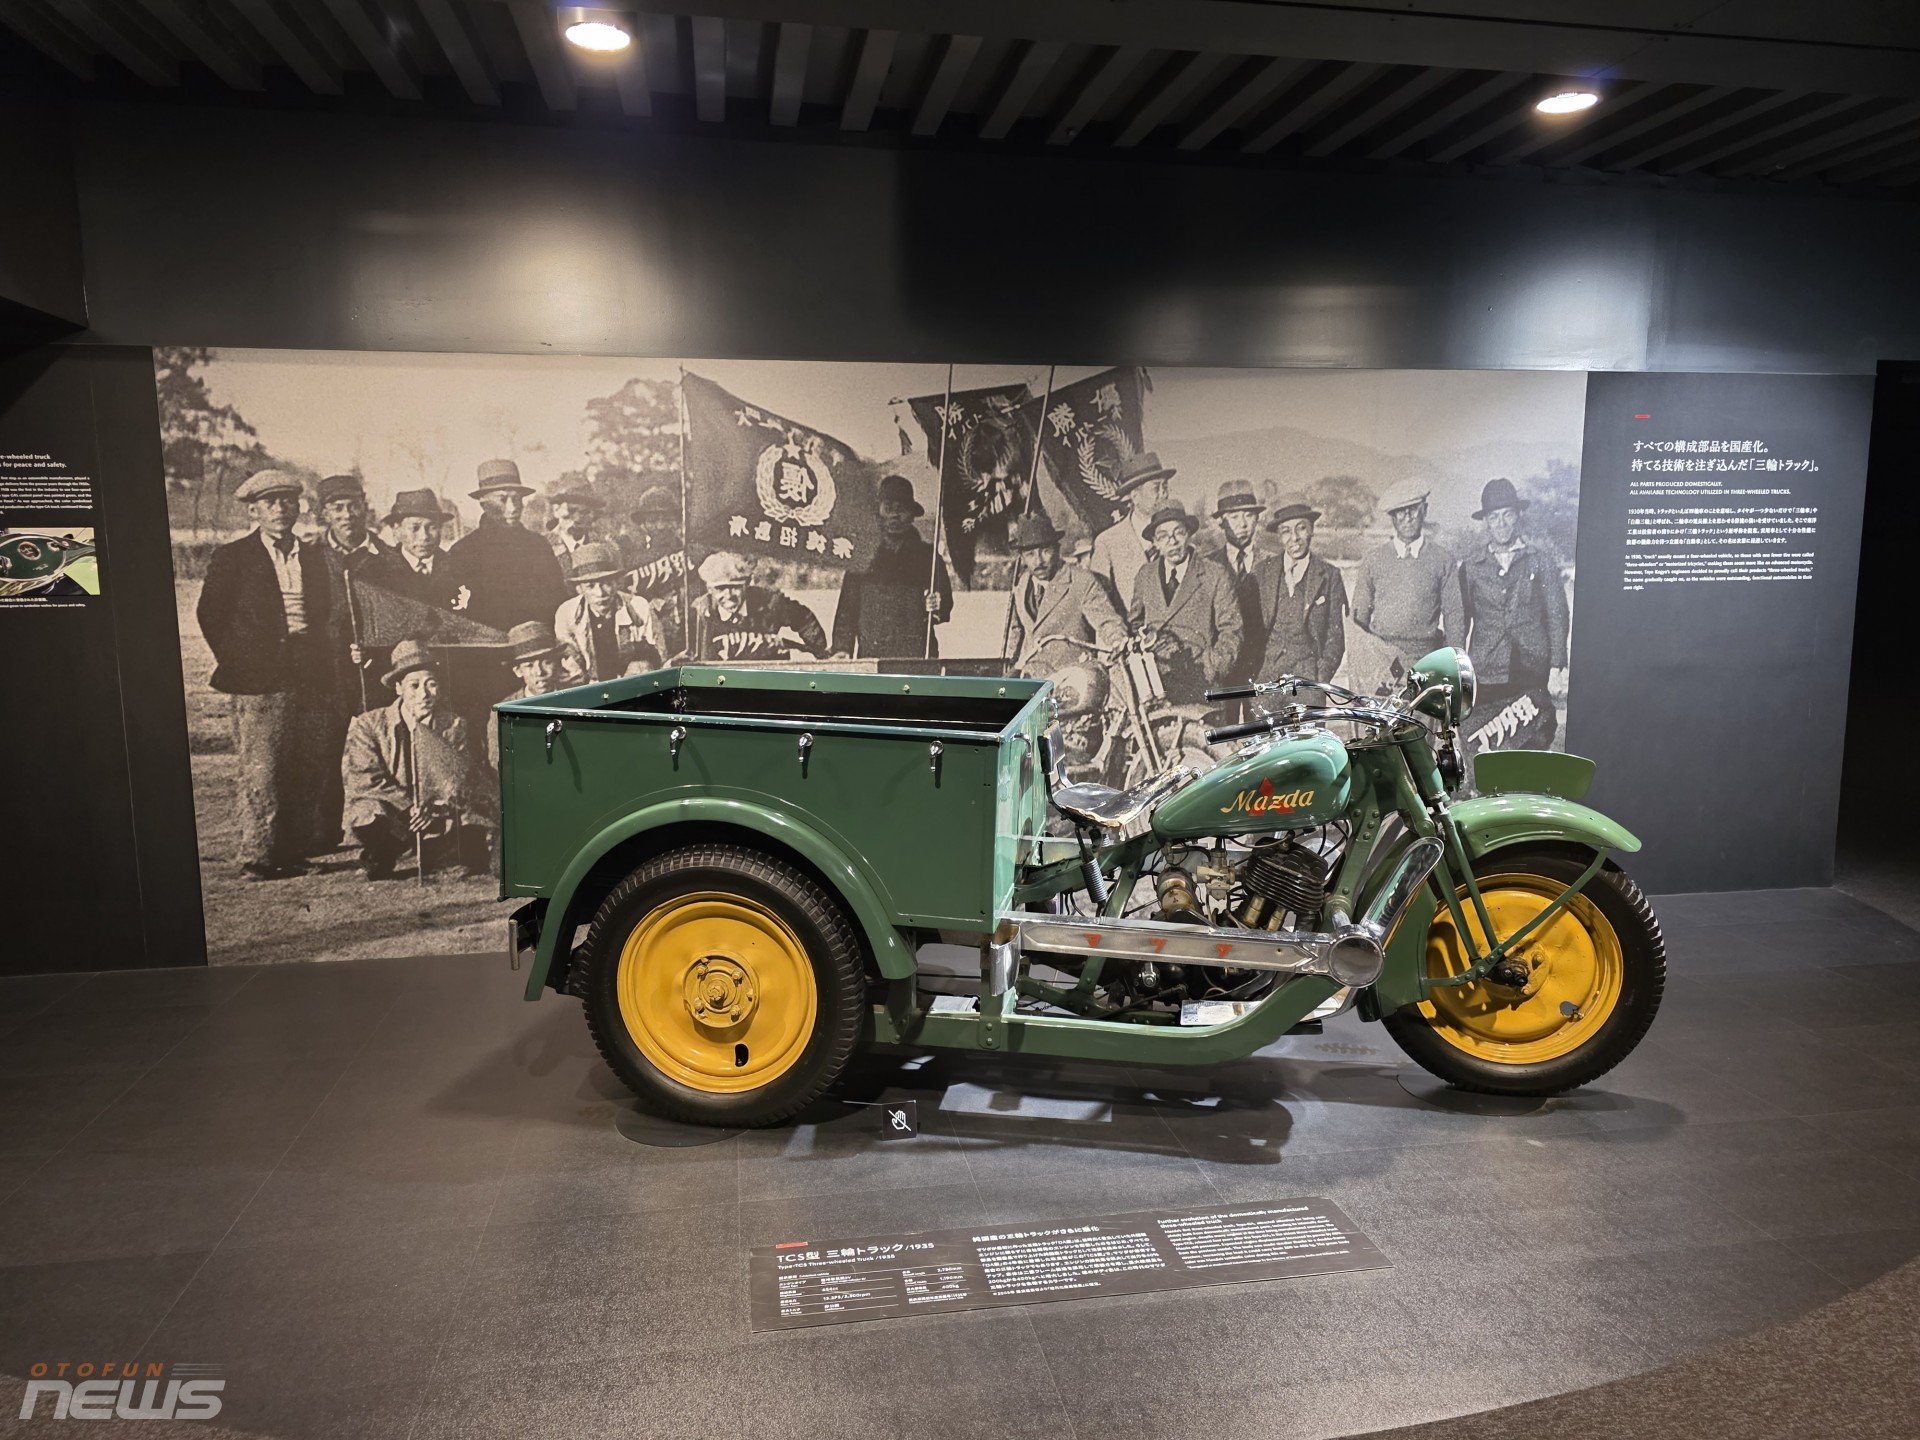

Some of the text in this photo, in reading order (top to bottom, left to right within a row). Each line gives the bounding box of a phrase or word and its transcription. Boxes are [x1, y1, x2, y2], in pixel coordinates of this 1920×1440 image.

[1633, 440, 1768, 453] すべての構成部品を国産化。
[1631, 459, 1819, 472] 持てる技術を注ぎ込んだ「三輪トラック」。
[1220, 789, 1314, 813] Mazda
[1229, 1210, 1266, 1218] domestically
[777, 1242, 934, 1263] TCS型 三輪トラック /1935
